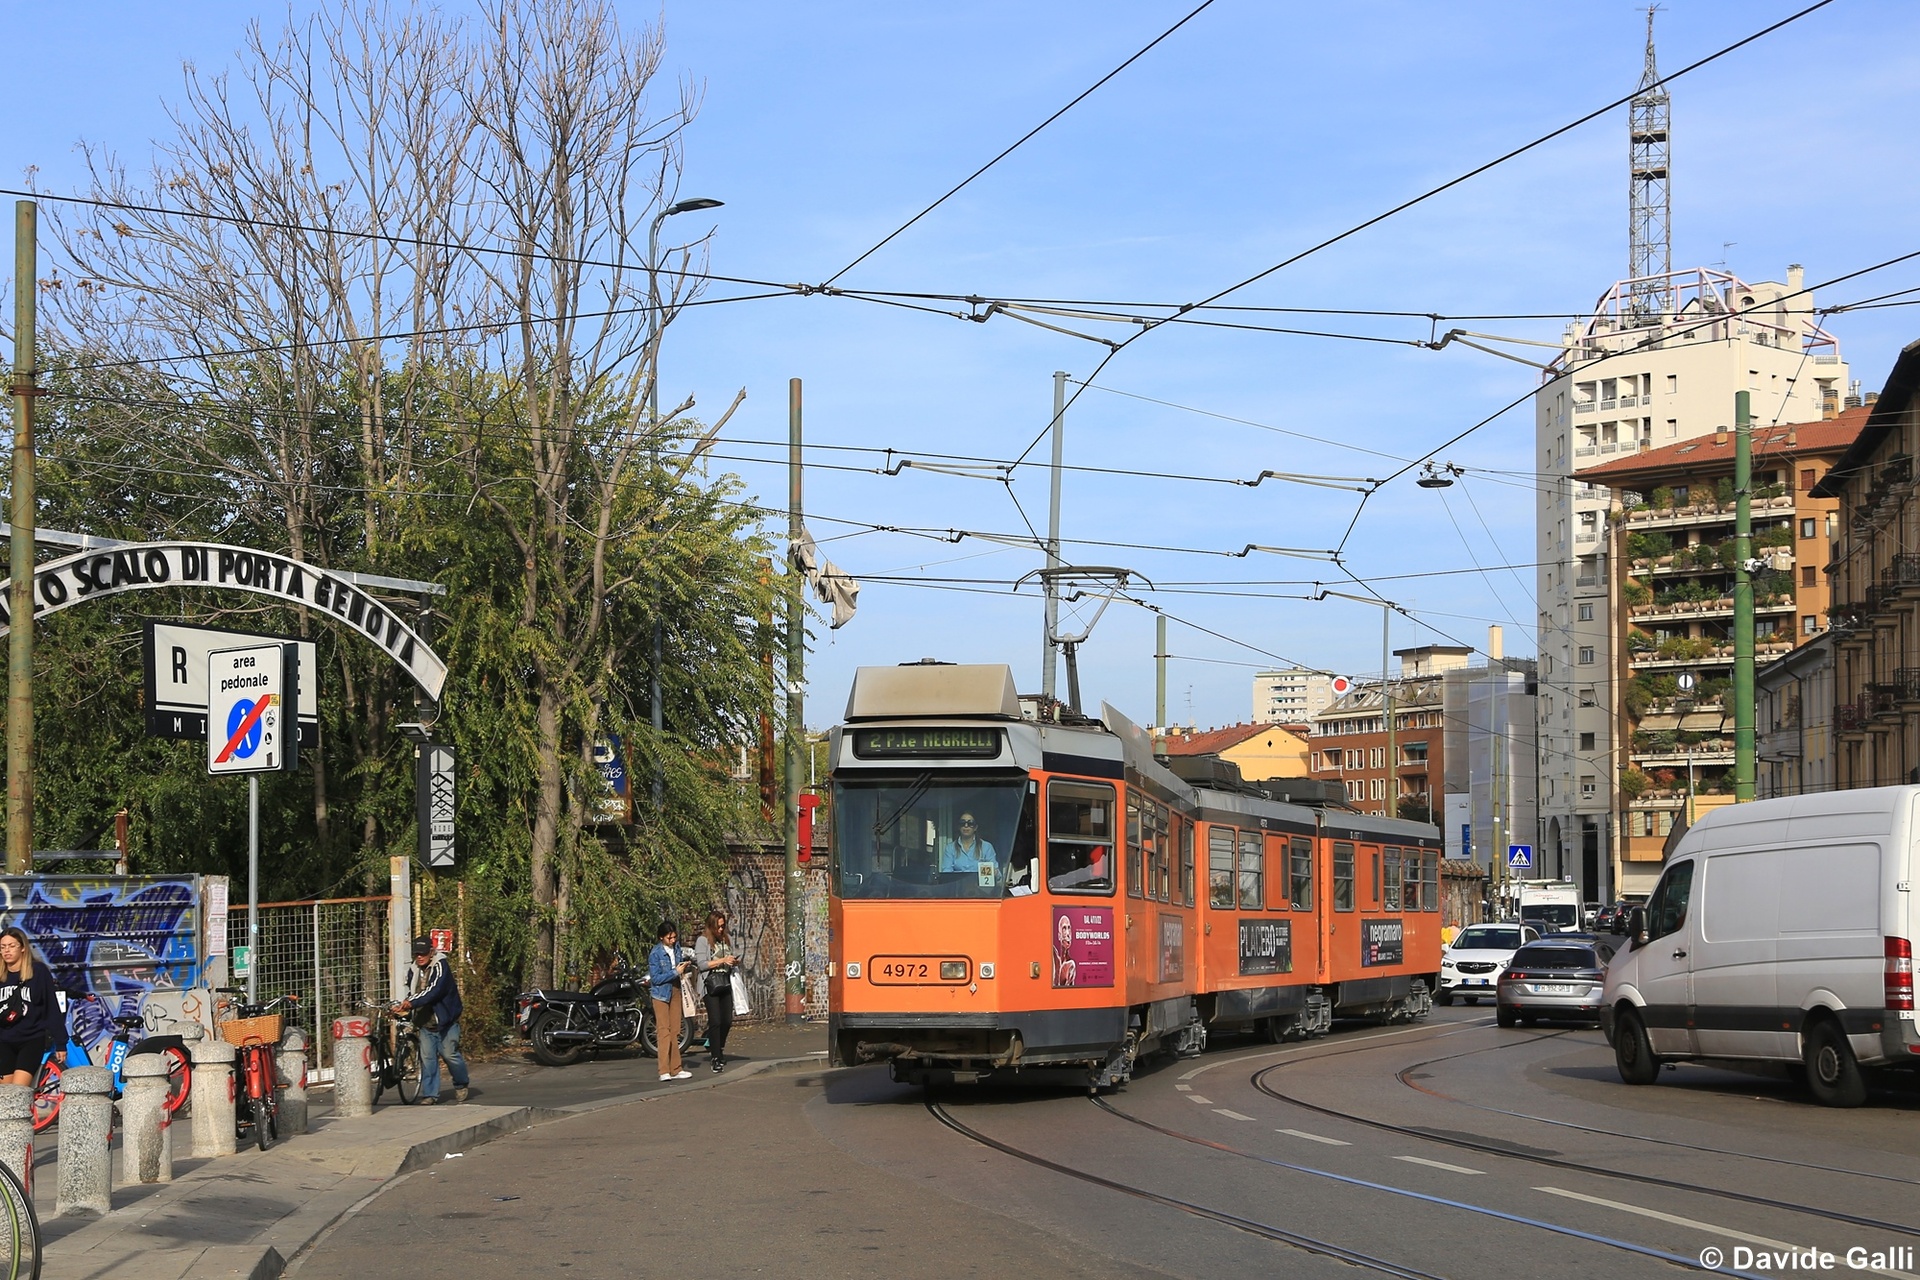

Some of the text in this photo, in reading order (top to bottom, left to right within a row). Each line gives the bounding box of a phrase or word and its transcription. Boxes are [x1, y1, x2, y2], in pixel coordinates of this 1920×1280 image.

[72, 547, 415, 669] SCALO DI PORTA GENOVA
[233, 656, 256, 669] area
[221, 673, 269, 692] pedonale
[922, 731, 993, 748] NEGRELLI
[980, 866, 992, 876] 42
[984, 876, 990, 885] 2
[1240, 924, 1276, 958] PLACEBO
[1370, 924, 1402, 947] negramaro
[883, 963, 928, 977] 4972
[111, 1045, 126, 1073] dott
